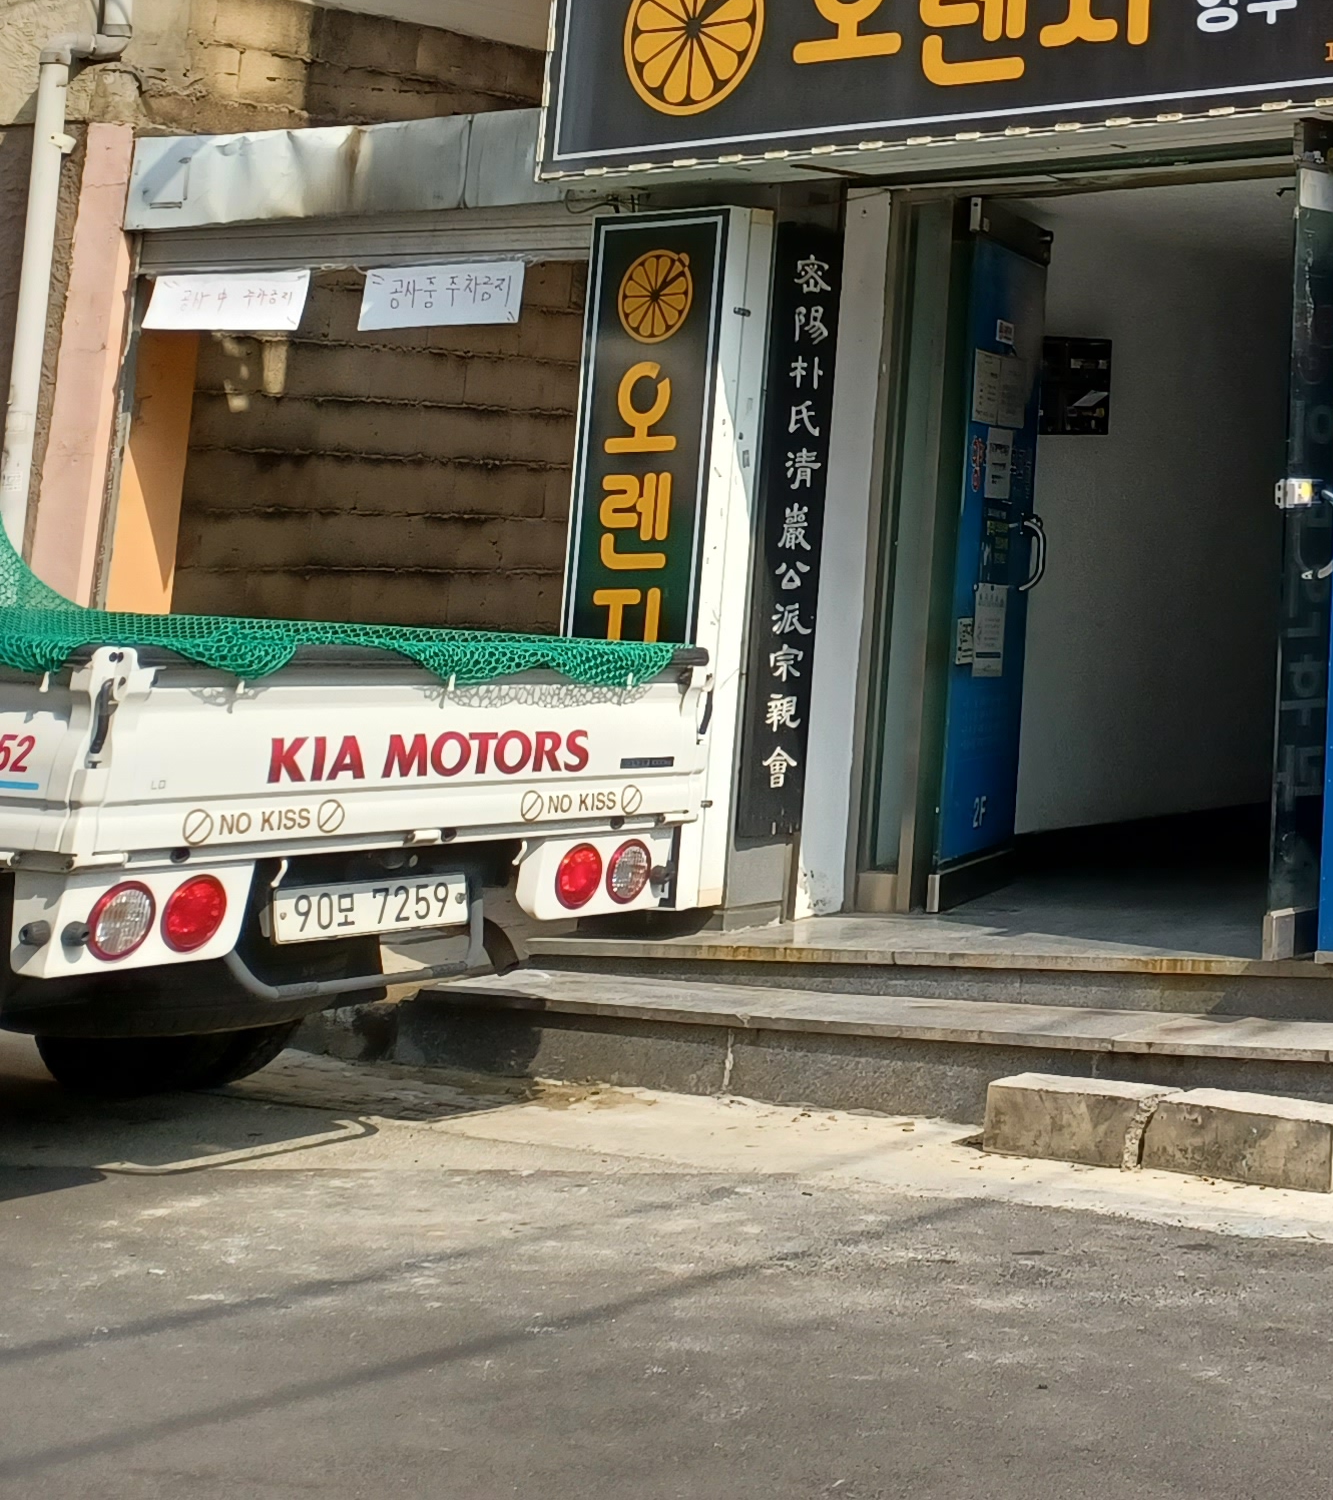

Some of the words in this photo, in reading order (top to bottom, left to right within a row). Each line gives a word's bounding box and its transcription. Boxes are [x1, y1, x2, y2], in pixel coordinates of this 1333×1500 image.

[445, 274, 512, 308] 주차금지
[267, 735, 365, 784] KIA
[381, 729, 589, 779] MOTORS
[547, 794, 573, 815] NO
[578, 791, 617, 812] KISS
[972, 795, 987, 829] 2F
[219, 812, 251, 836] NO
[259, 807, 311, 833] KISS
[294, 893, 356, 932] 90모
[372, 882, 450, 925] 7259
